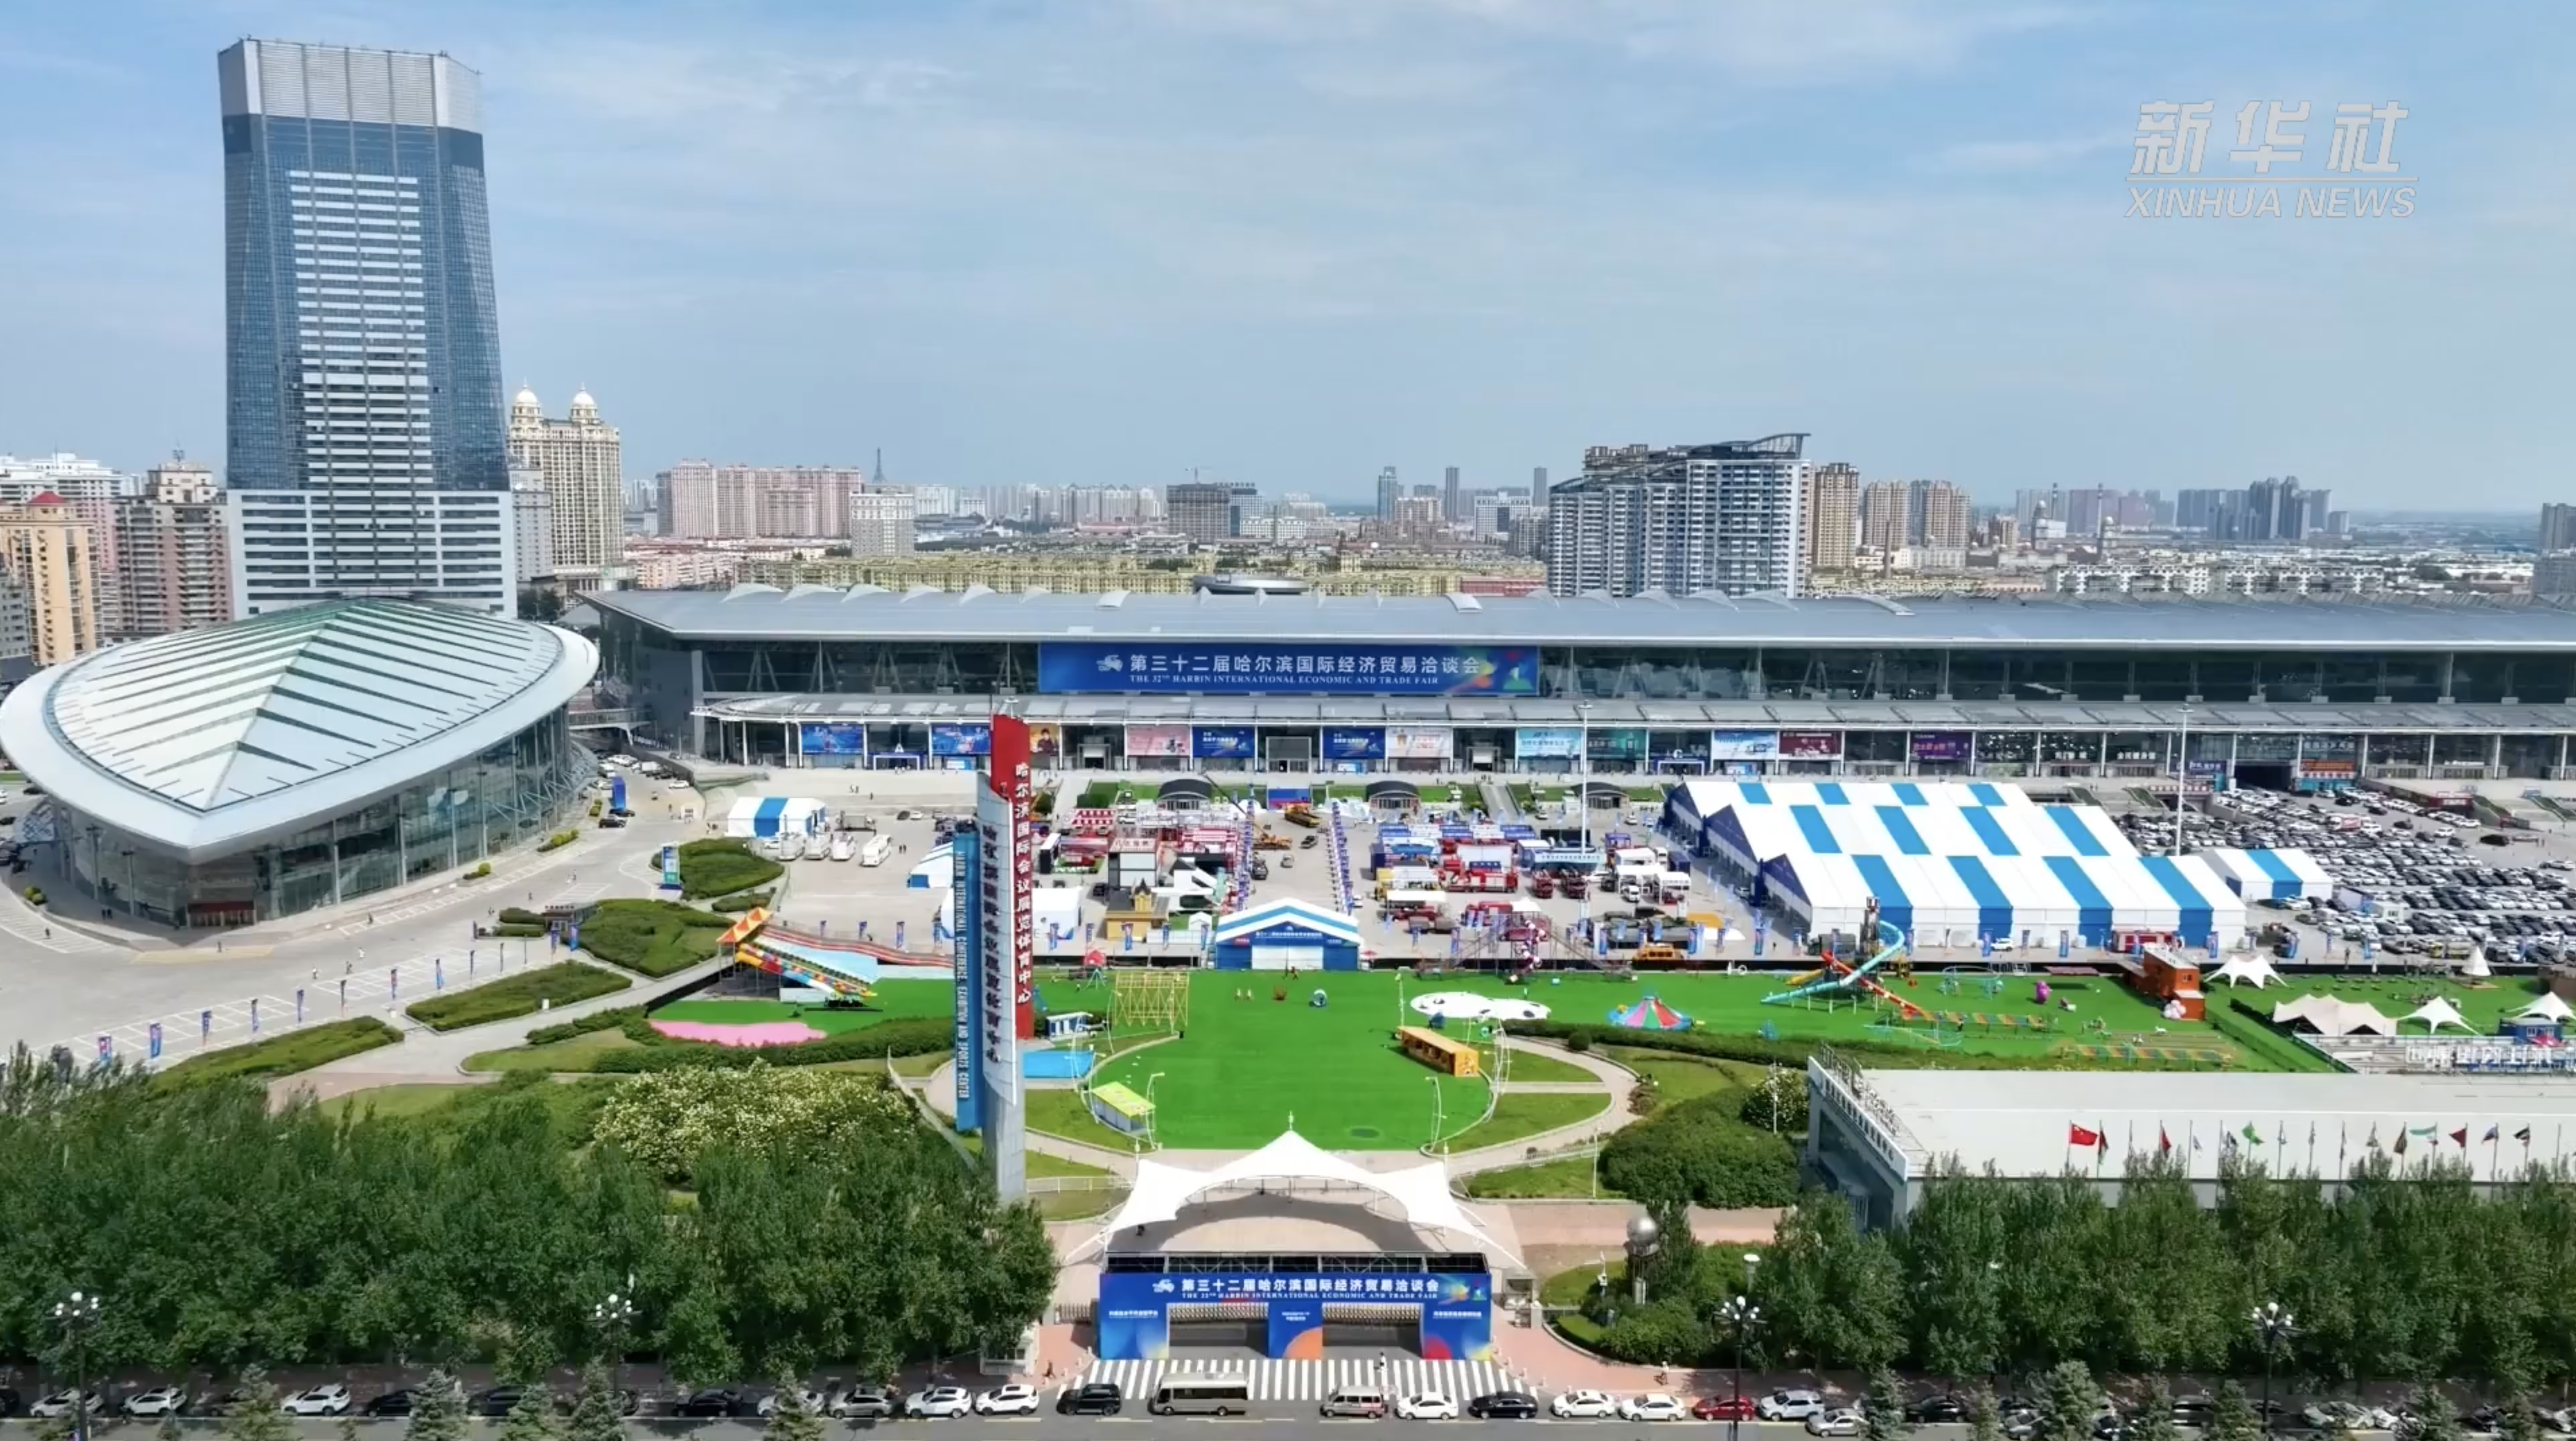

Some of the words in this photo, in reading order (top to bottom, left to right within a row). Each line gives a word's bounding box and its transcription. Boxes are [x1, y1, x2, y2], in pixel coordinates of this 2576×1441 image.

[1130, 654, 1480, 674] 第三十二届哈尔滨国际经济贸易洽谈会
[1214, 675, 1296, 684] INTERNATIONAL
[1299, 676, 1352, 684] ECONOMIC
[1015, 762, 1032, 1004] 哈尔滨国际会议展览体育中心
[955, 881, 967, 932] INTERNATIONAL
[958, 1025, 969, 1038] AND
[958, 1042, 969, 1068] SPORTS
[958, 1072, 969, 1098] CENTER
[1182, 1279, 1439, 1292] 第三十二届哈尔滨国际经济贸易洽谈会
